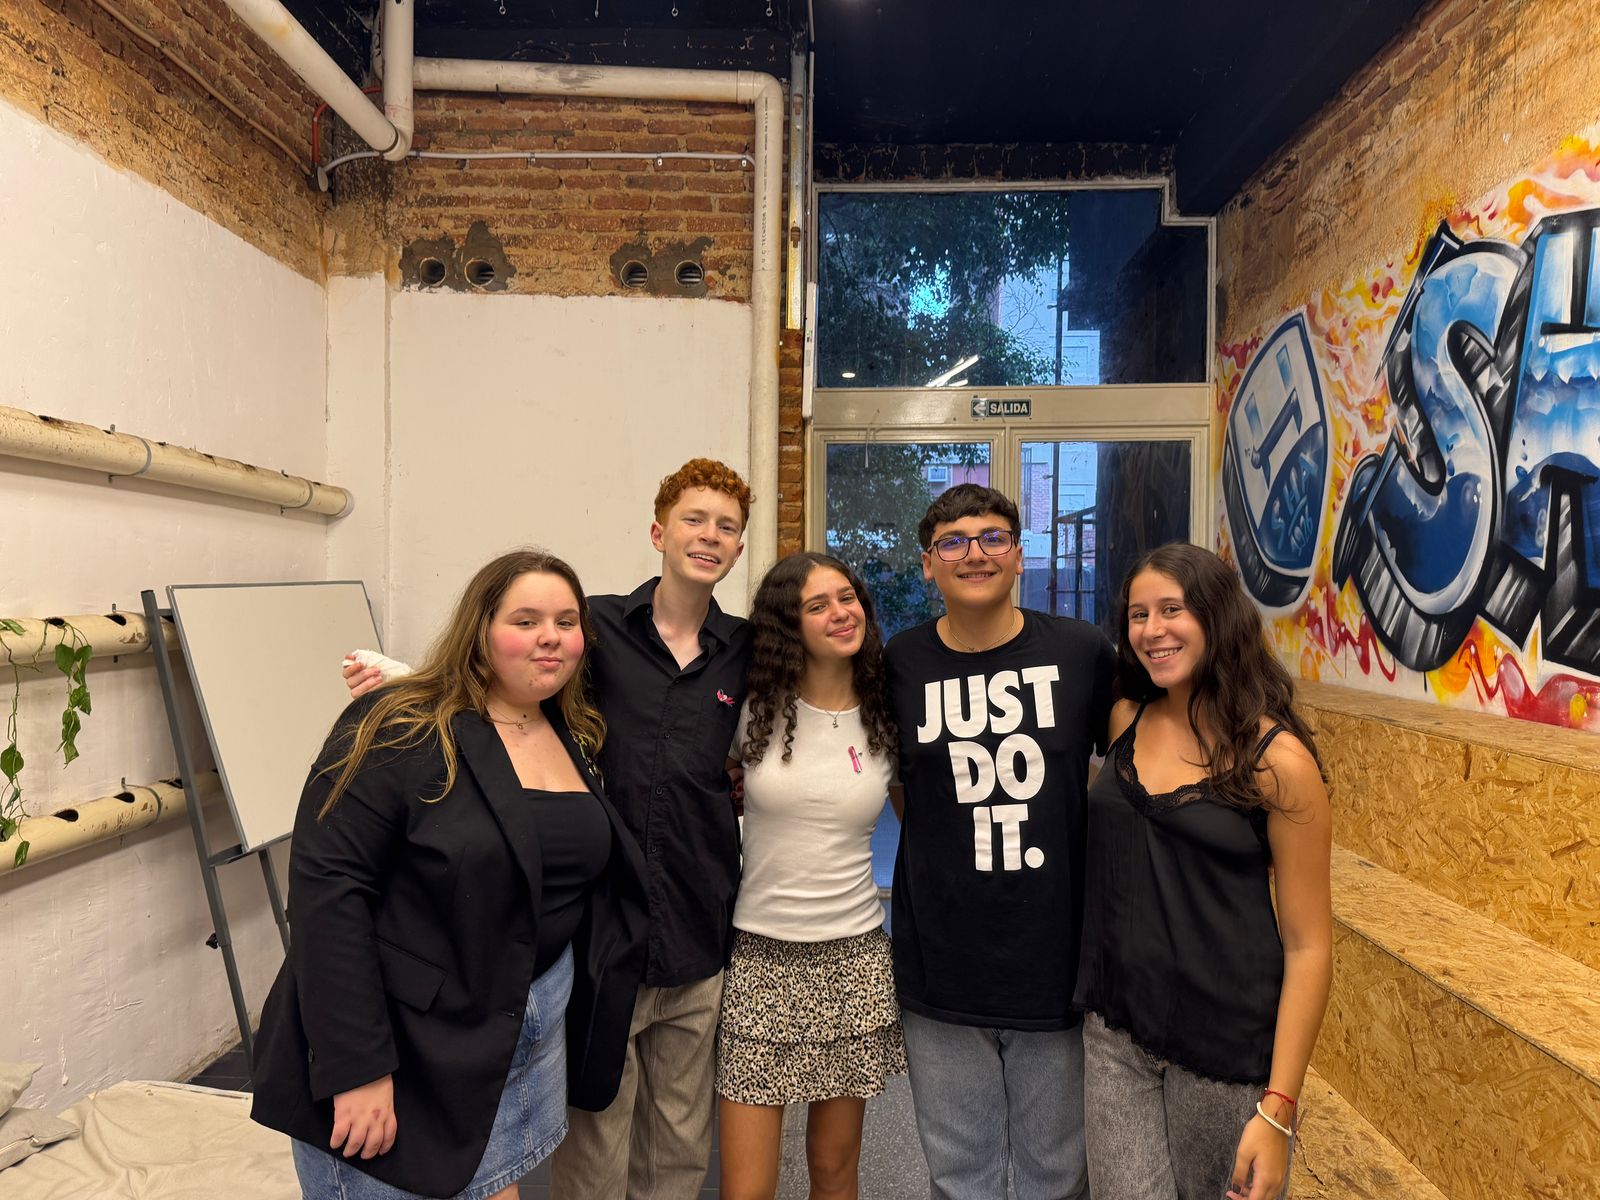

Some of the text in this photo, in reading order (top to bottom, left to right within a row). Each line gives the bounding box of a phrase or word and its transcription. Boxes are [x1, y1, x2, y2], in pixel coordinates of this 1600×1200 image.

[990, 403, 1028, 414] SALIDA
[917, 664, 1060, 744] JUST
[947, 733, 1046, 804] DO
[972, 803, 1045, 872] IT.
